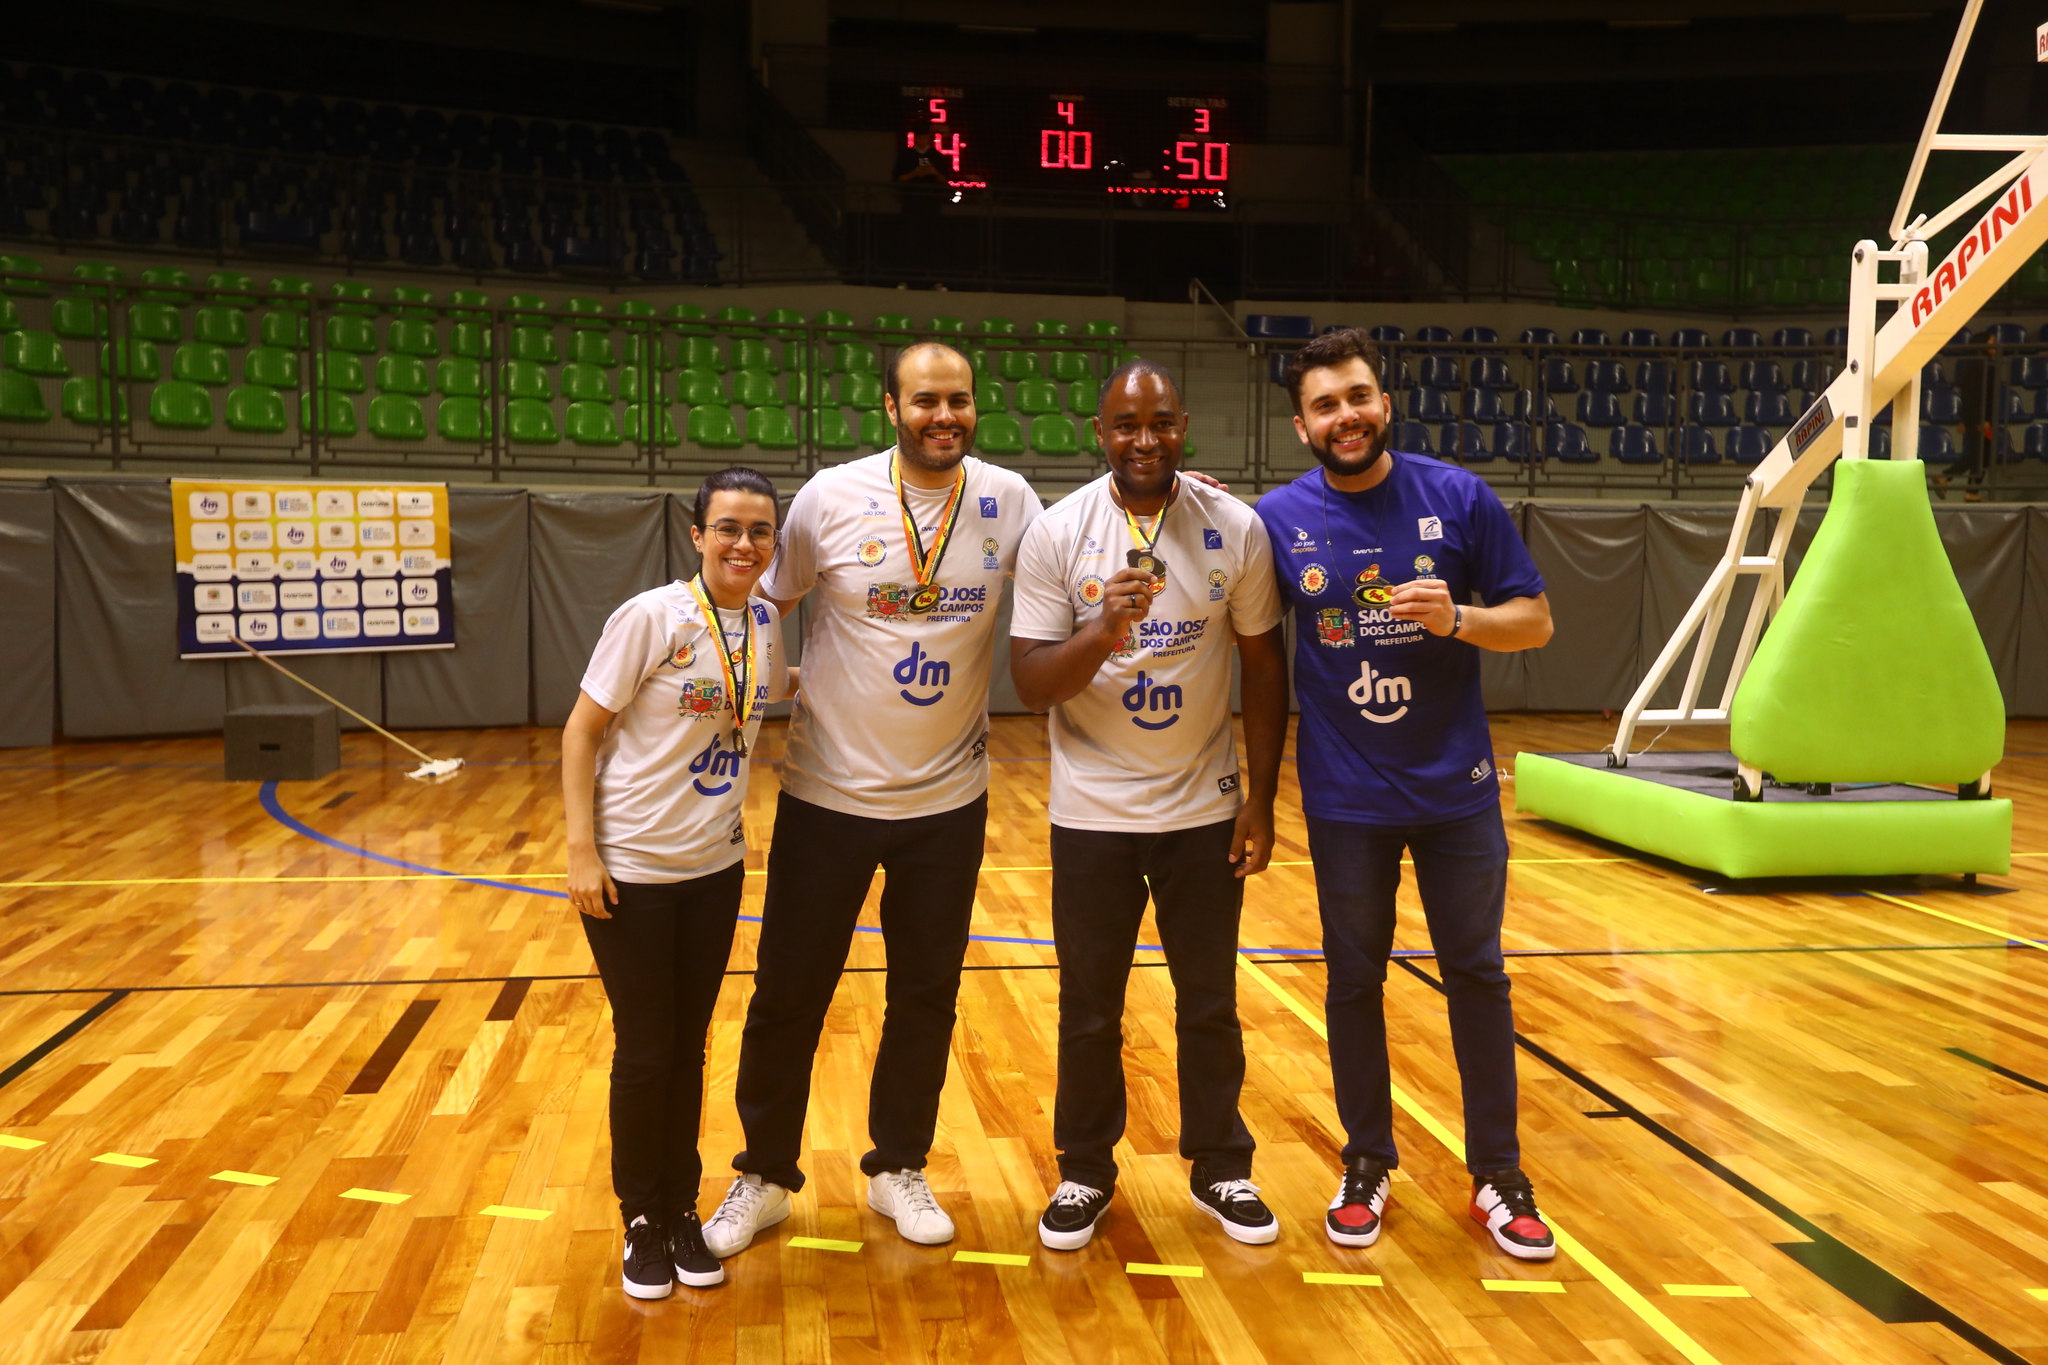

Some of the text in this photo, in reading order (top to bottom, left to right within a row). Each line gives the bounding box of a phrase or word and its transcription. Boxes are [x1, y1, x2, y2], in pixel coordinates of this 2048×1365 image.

[929, 98, 947, 124] 5
[1057, 101, 1075, 126] 4
[1193, 108, 1210, 133] 3
[1911, 174, 2033, 329] RAPINI
[1795, 409, 1825, 448] RAPINI
[949, 584, 986, 602] JOSÉ
[940, 603, 985, 613] CAMPOS
[1139, 616, 1210, 636] SÃO JOSÉ
[1360, 625, 1386, 637] DOS
[1140, 631, 1205, 648] DOS CAMPOS
[1375, 634, 1424, 646] PREFEITURA
[1153, 645, 1196, 658] PREFEITURA
